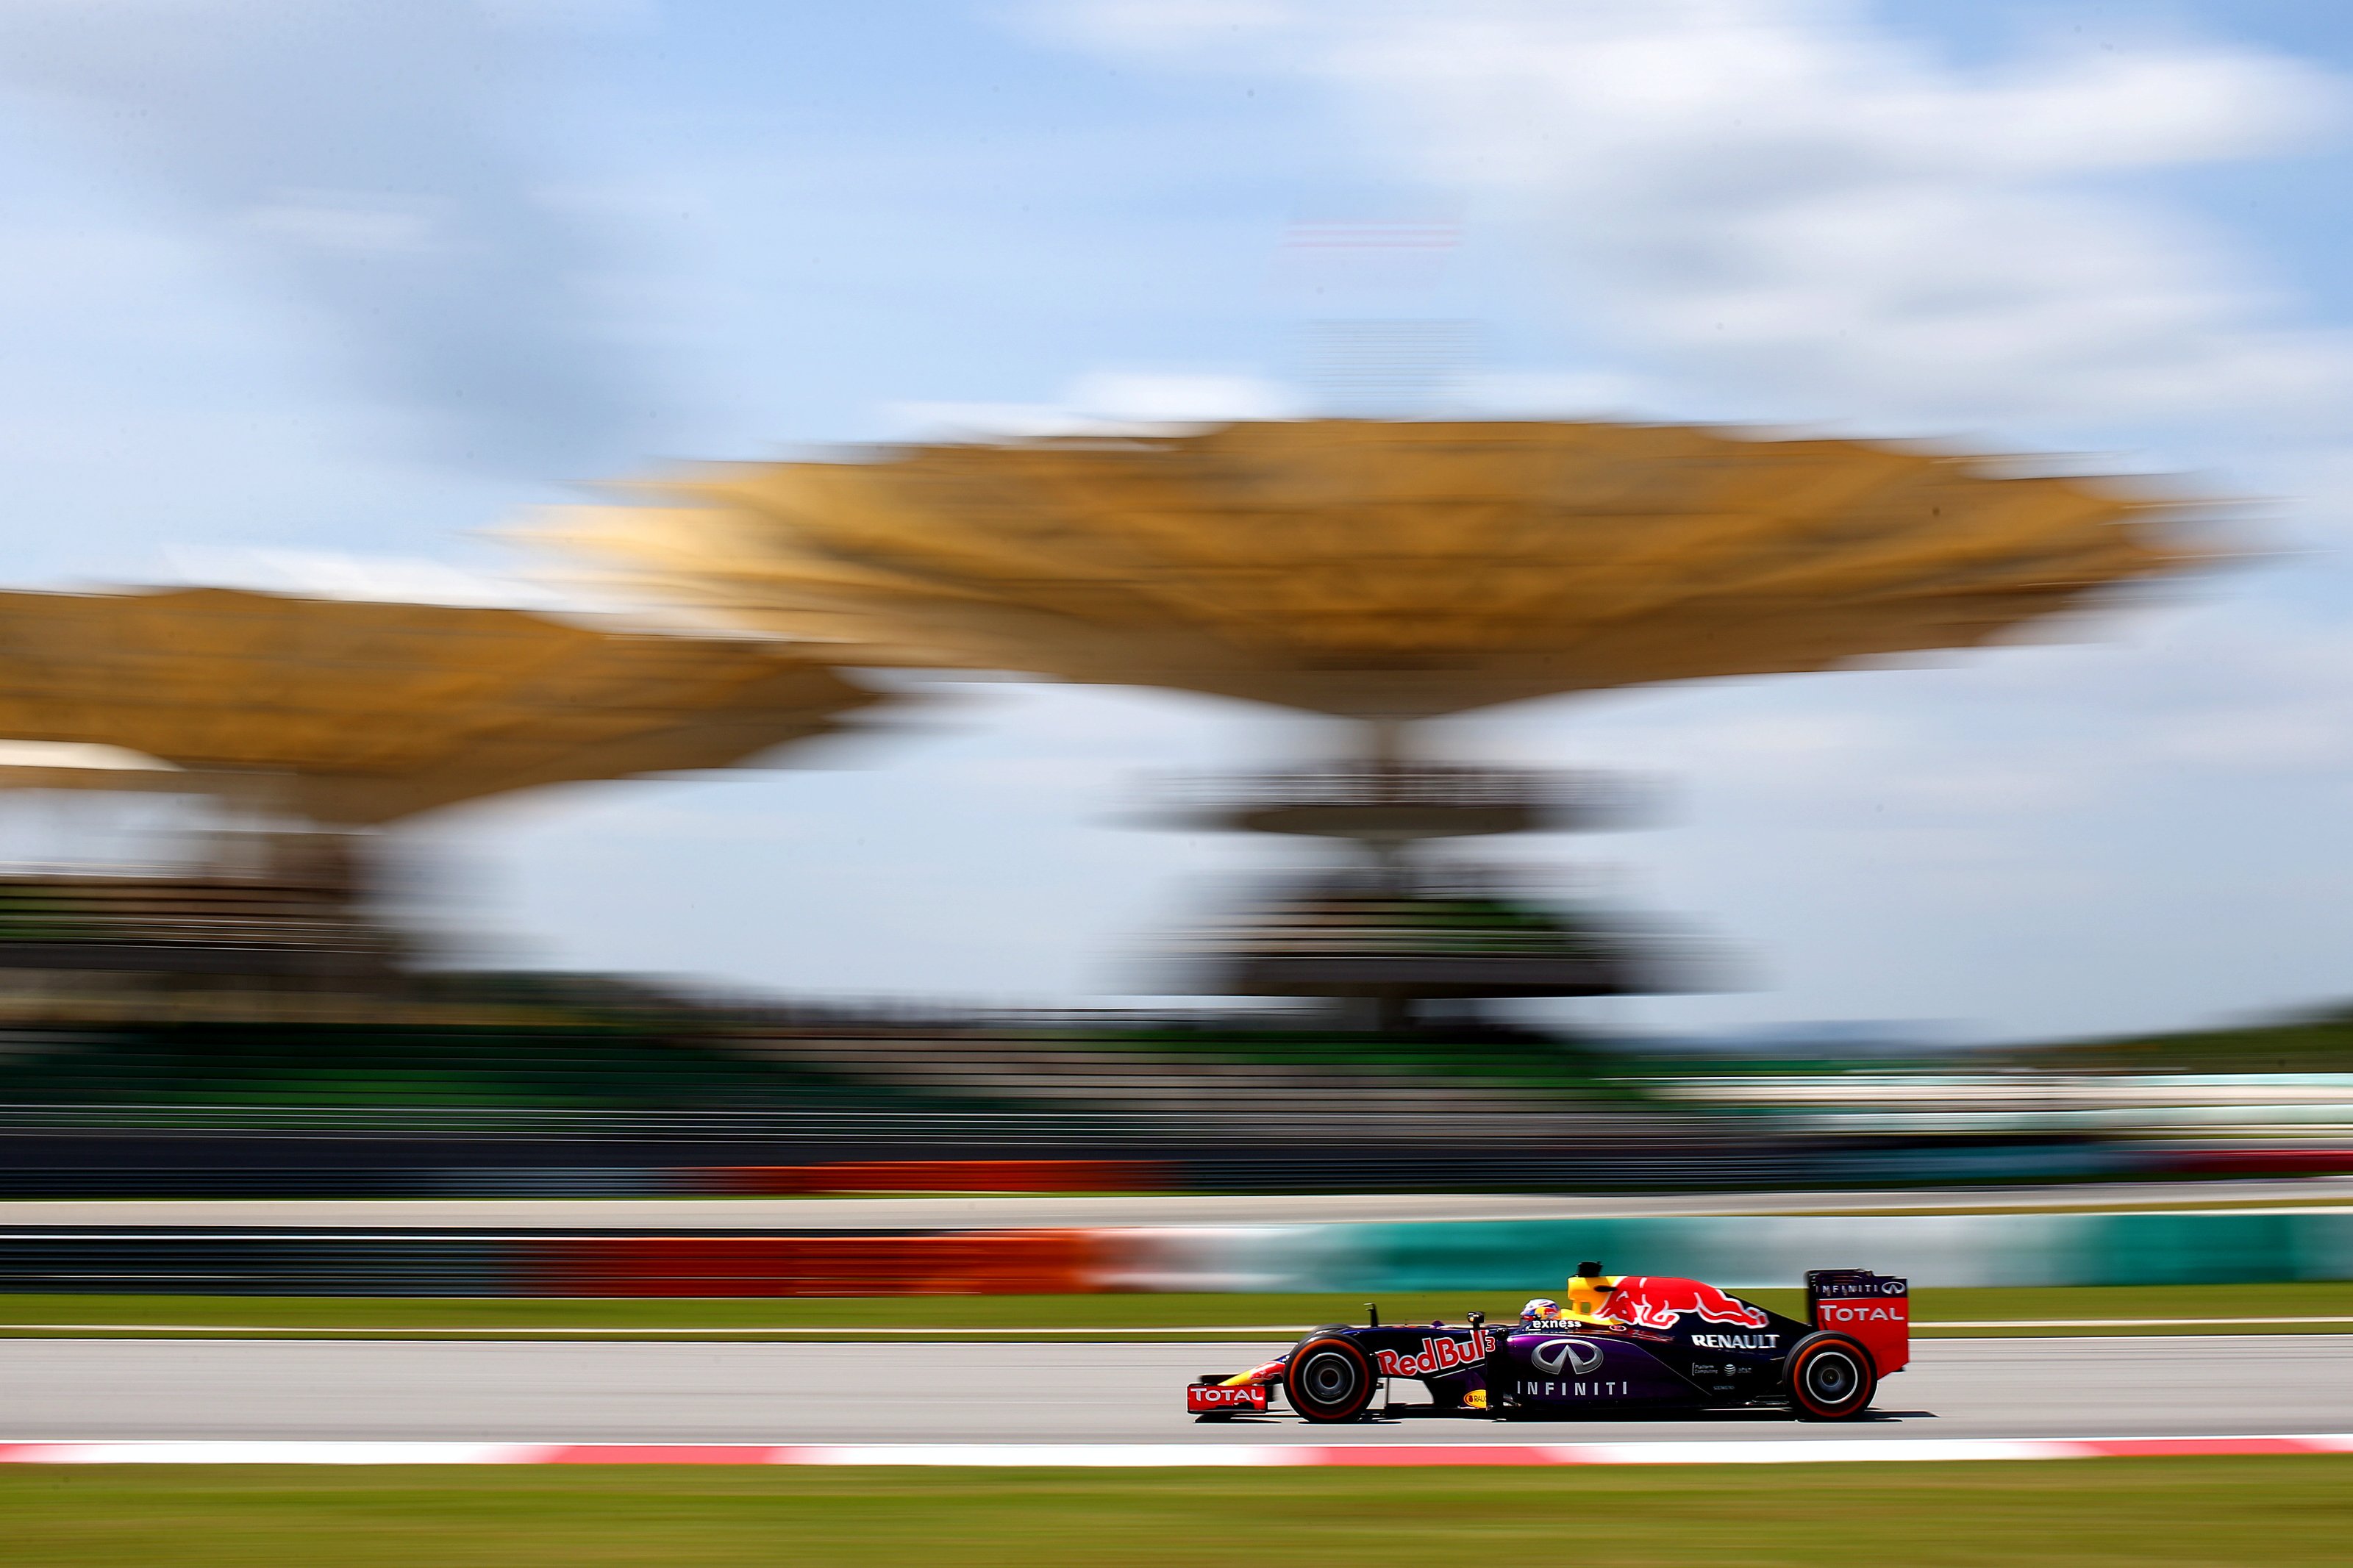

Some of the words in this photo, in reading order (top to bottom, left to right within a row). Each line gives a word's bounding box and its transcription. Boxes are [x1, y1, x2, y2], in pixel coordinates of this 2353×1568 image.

[1819, 1305, 1905, 1322] TOTAL
[1532, 1320, 1582, 1328] exness
[1485, 1336, 1496, 1353] 3
[1690, 1334, 1780, 1349] RENAULT
[1190, 1388, 1264, 1402] TOTAL
[1517, 1381, 1627, 1396] INFINITI
